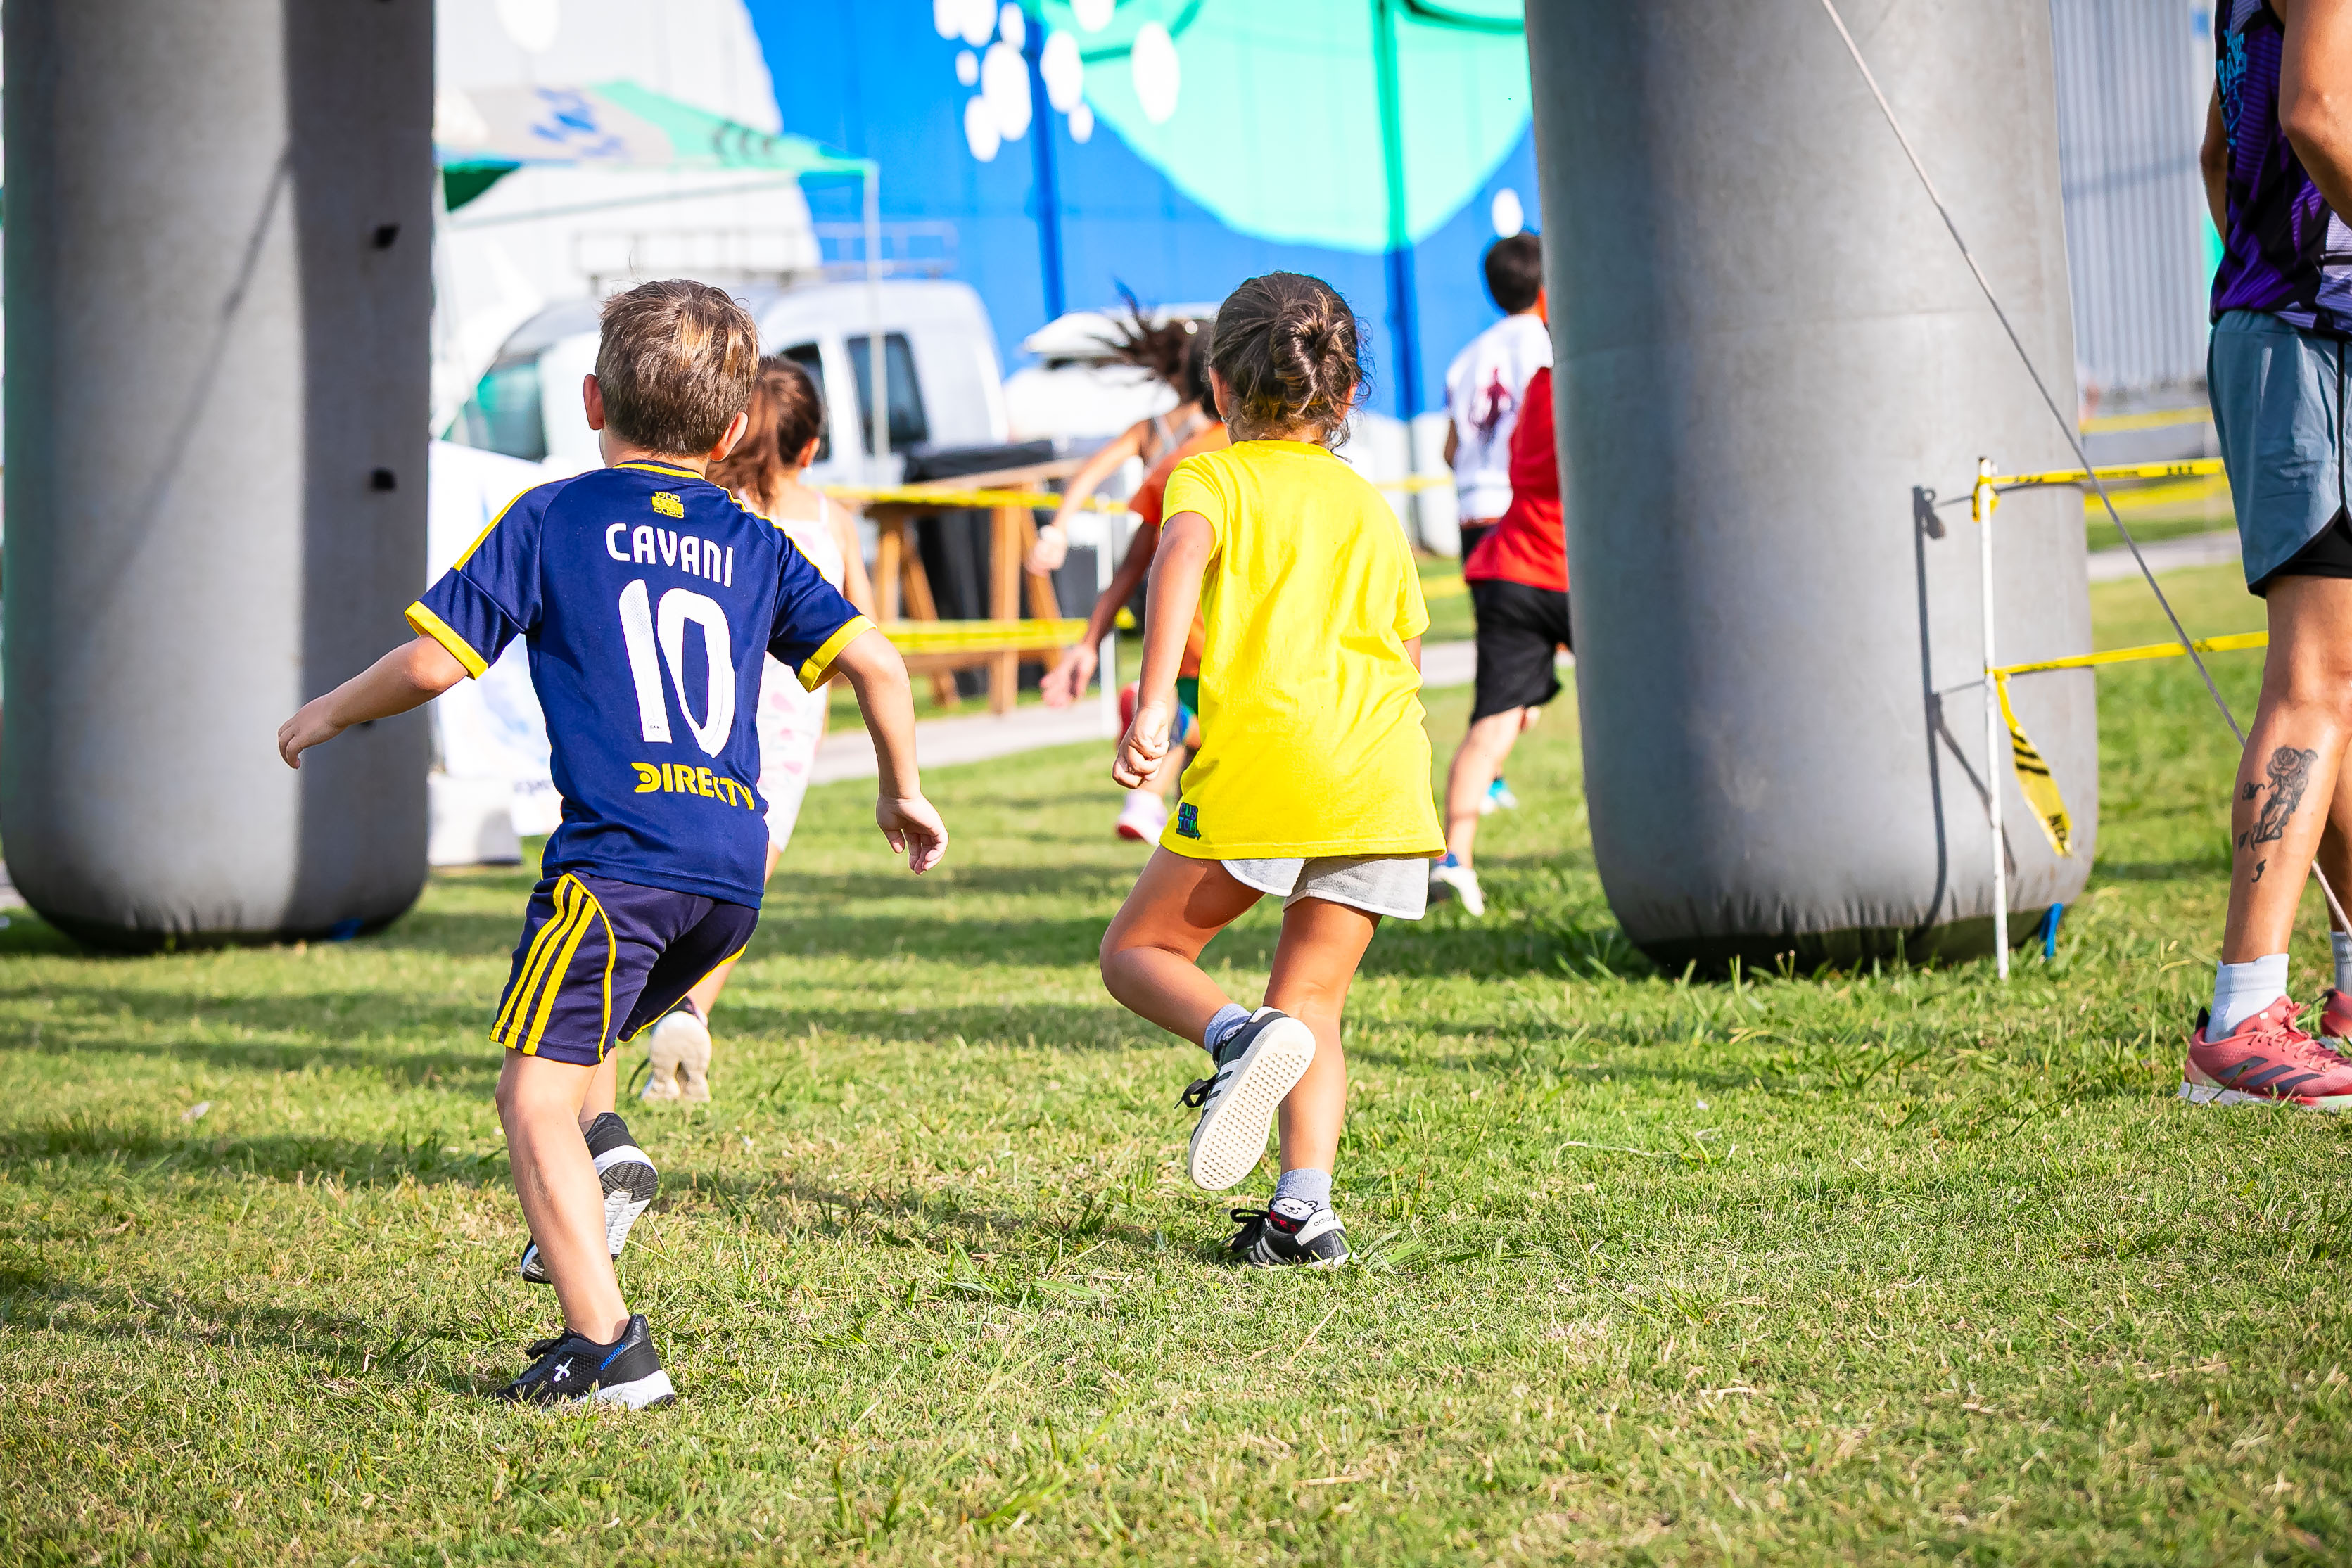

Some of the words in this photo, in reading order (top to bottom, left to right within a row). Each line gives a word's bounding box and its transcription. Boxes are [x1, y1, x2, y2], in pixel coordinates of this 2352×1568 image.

[605, 523, 734, 588] CAVANI
[618, 578, 736, 758] 10
[630, 762, 756, 810] DIRECTV
[1178, 816, 1197, 834] TOM
[1179, 803, 1197, 820] CUS
